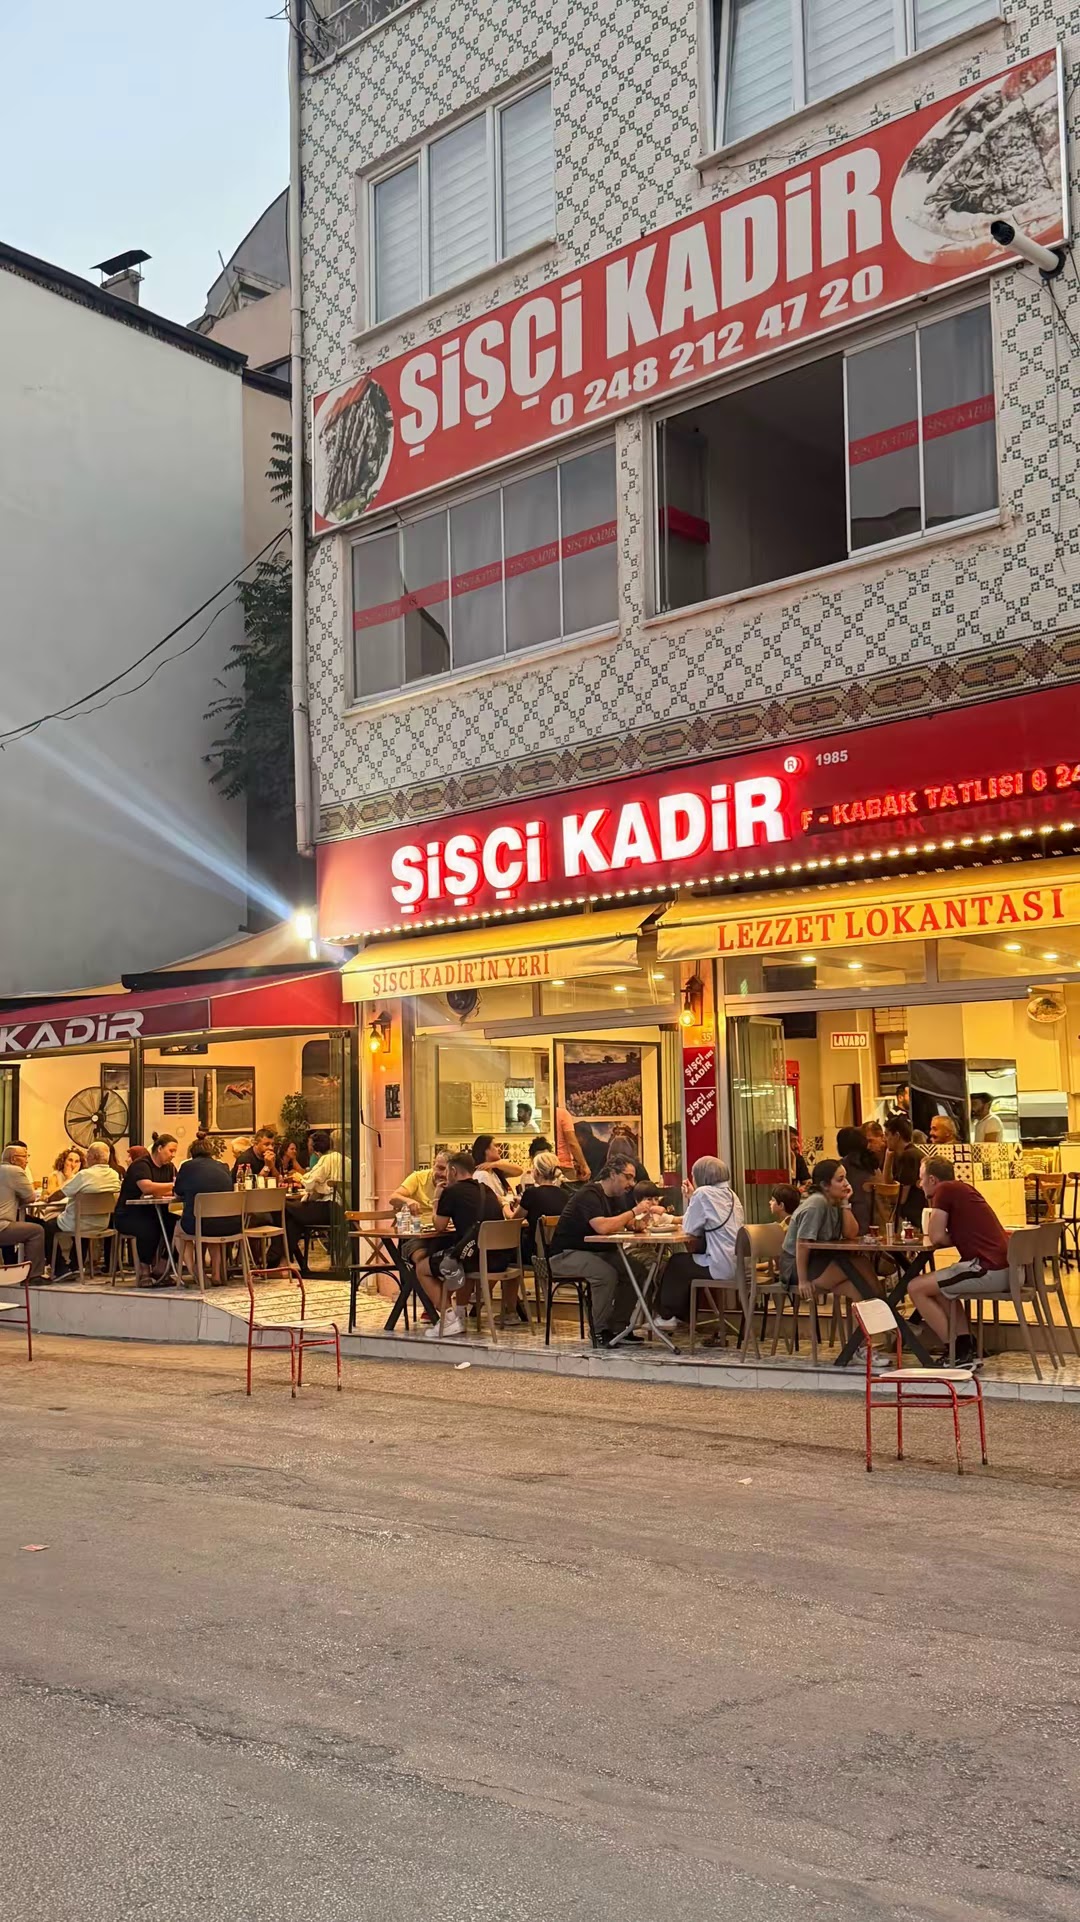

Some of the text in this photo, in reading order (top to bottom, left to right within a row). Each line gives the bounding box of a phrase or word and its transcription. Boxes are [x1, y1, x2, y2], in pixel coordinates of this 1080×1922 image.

[551, 265, 883, 426] 0 248 212 47 20
[815, 750, 848, 766] 1985
[832, 791, 918, 826] KABAK
[924, 772, 1024, 810] TATLISI
[718, 888, 1065, 951] LEZZET LOKANTASI
[504, 950, 550, 979] YERİ
[833, 1035, 866, 1047] LAVABO
